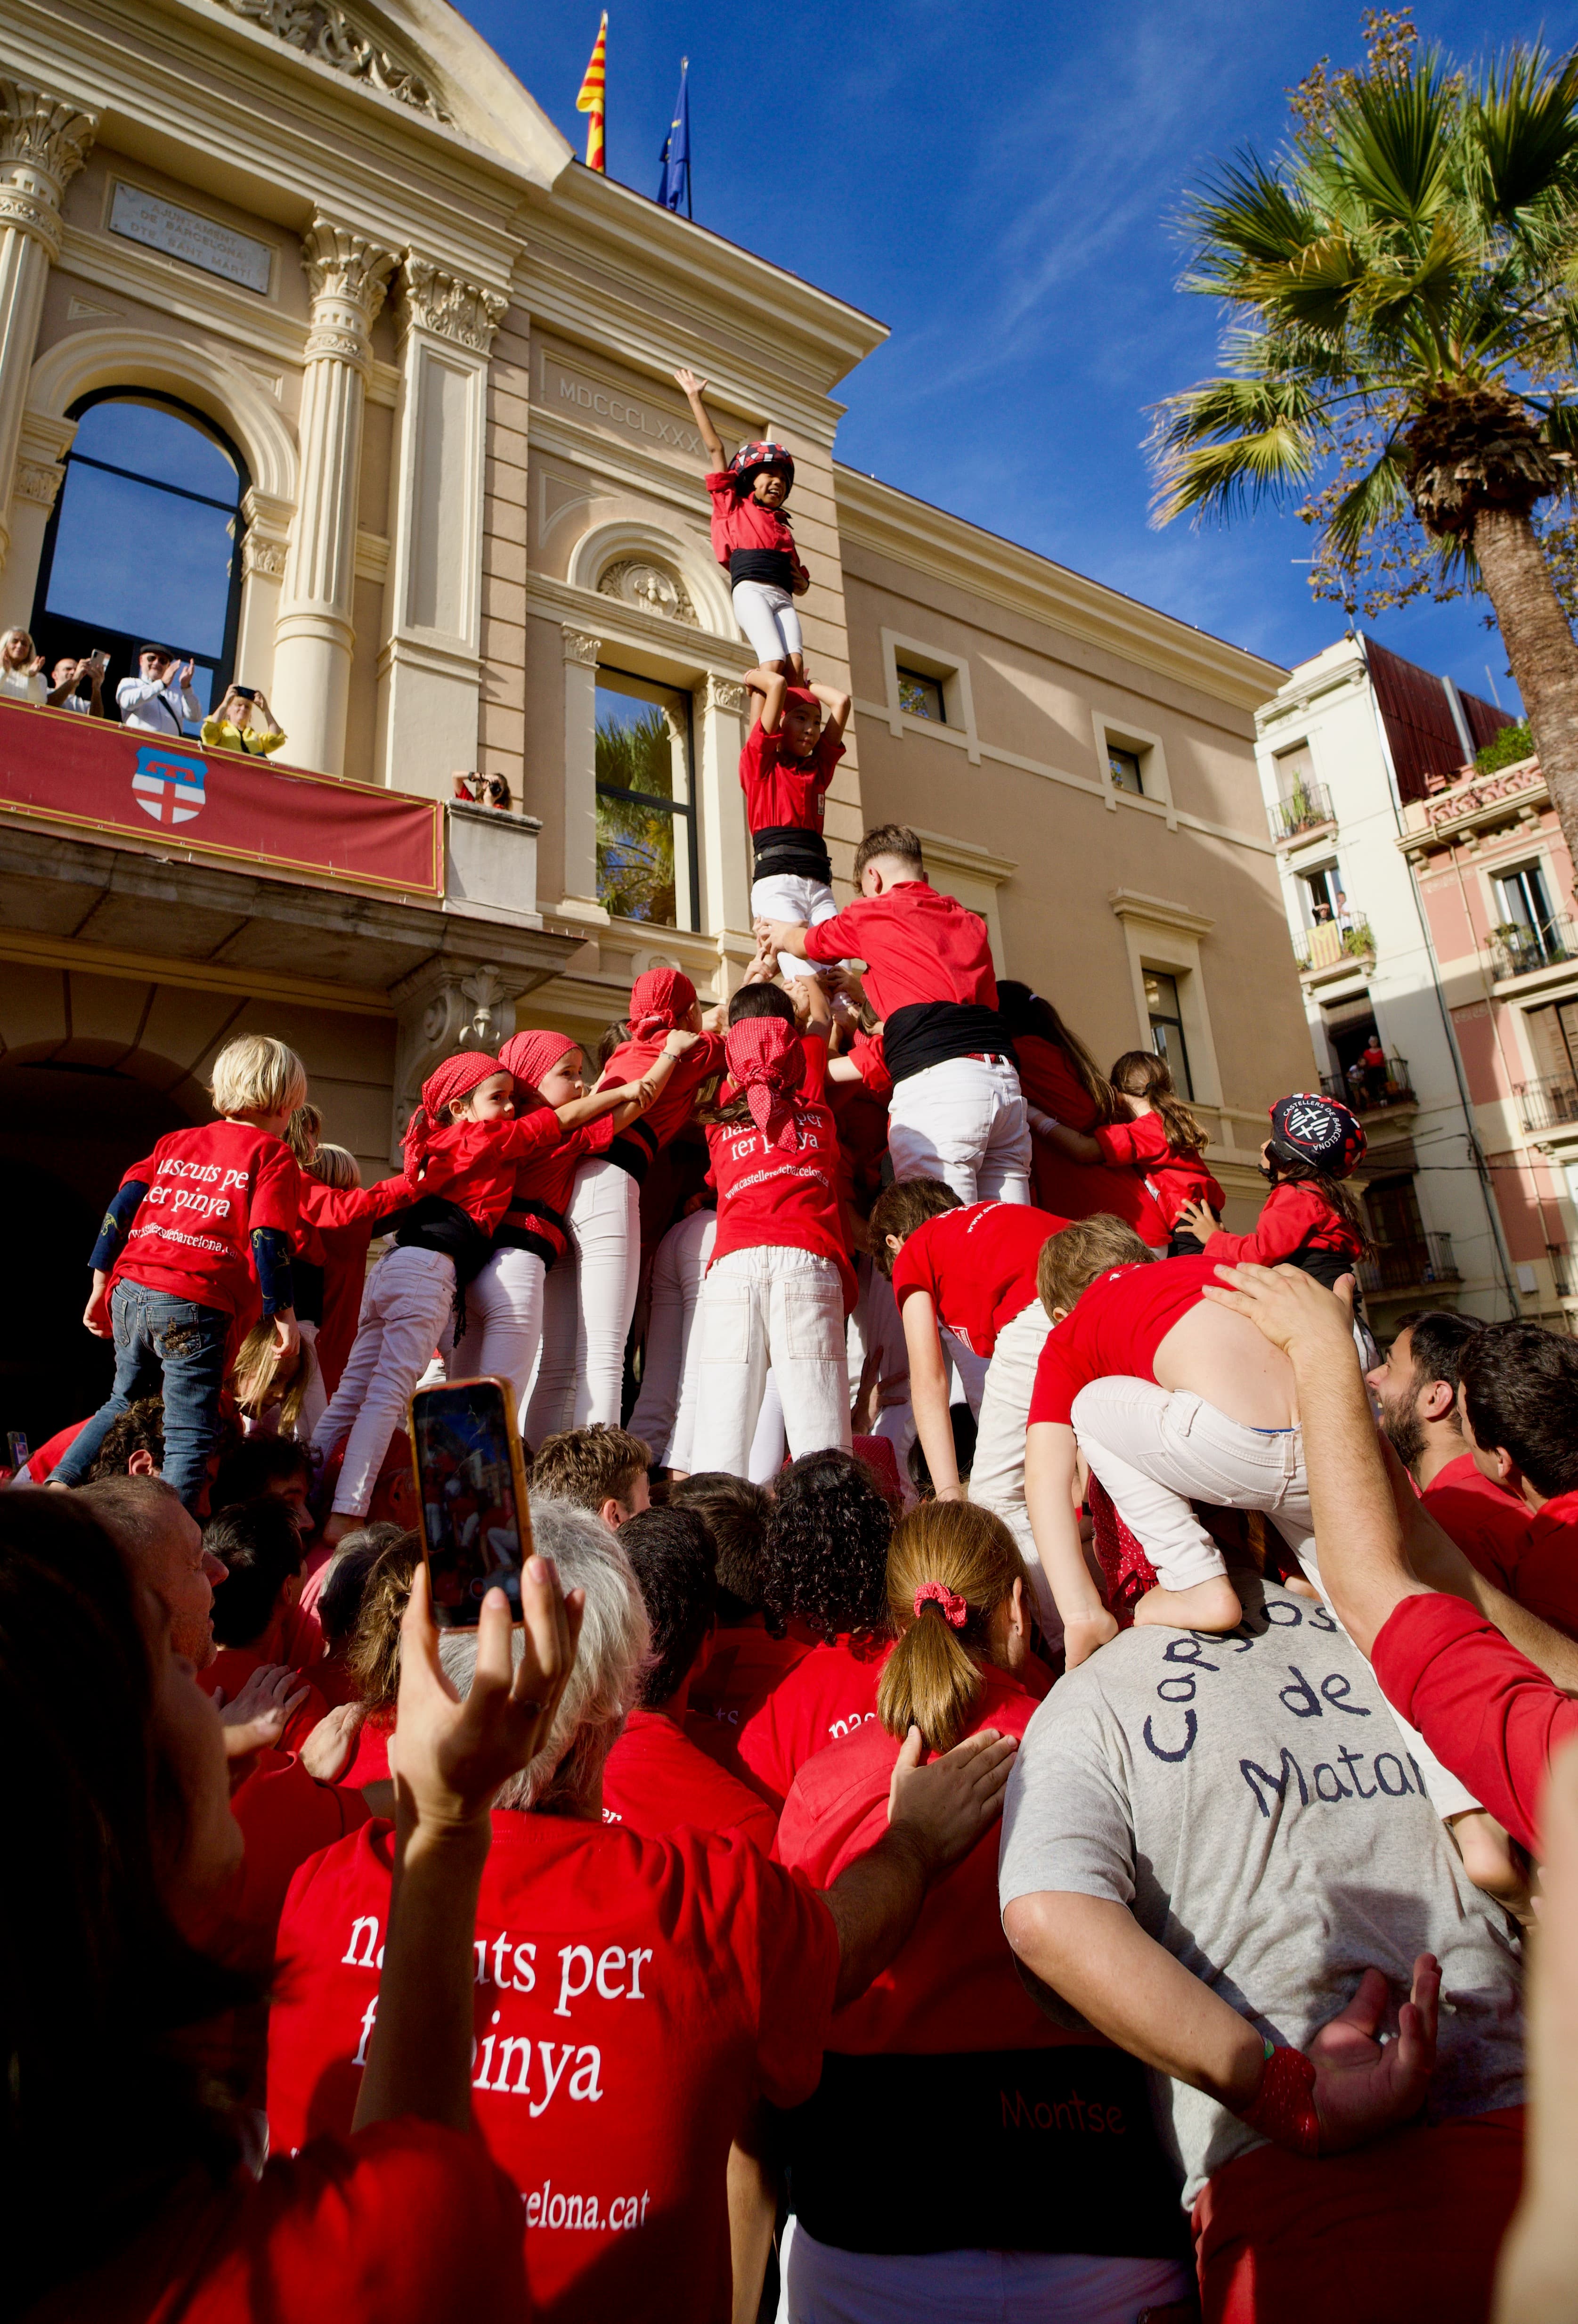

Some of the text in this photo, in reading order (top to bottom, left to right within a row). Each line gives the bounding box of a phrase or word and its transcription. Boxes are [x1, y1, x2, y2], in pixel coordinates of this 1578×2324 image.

[140, 210, 244, 260] DE BARCELONA
[168, 236, 203, 259] SANT
[796, 1112, 823, 1128] per
[1283, 1100, 1342, 1151] CASTELLERS DE BARCELONA
[143, 1184, 230, 1219] er pinya
[218, 1169, 249, 1191] pe
[1278, 1665, 1371, 1717] de
[553, 1944, 653, 2017] per
[470, 2010, 604, 2118] inya
[1000, 2088, 1127, 2135] Montse
